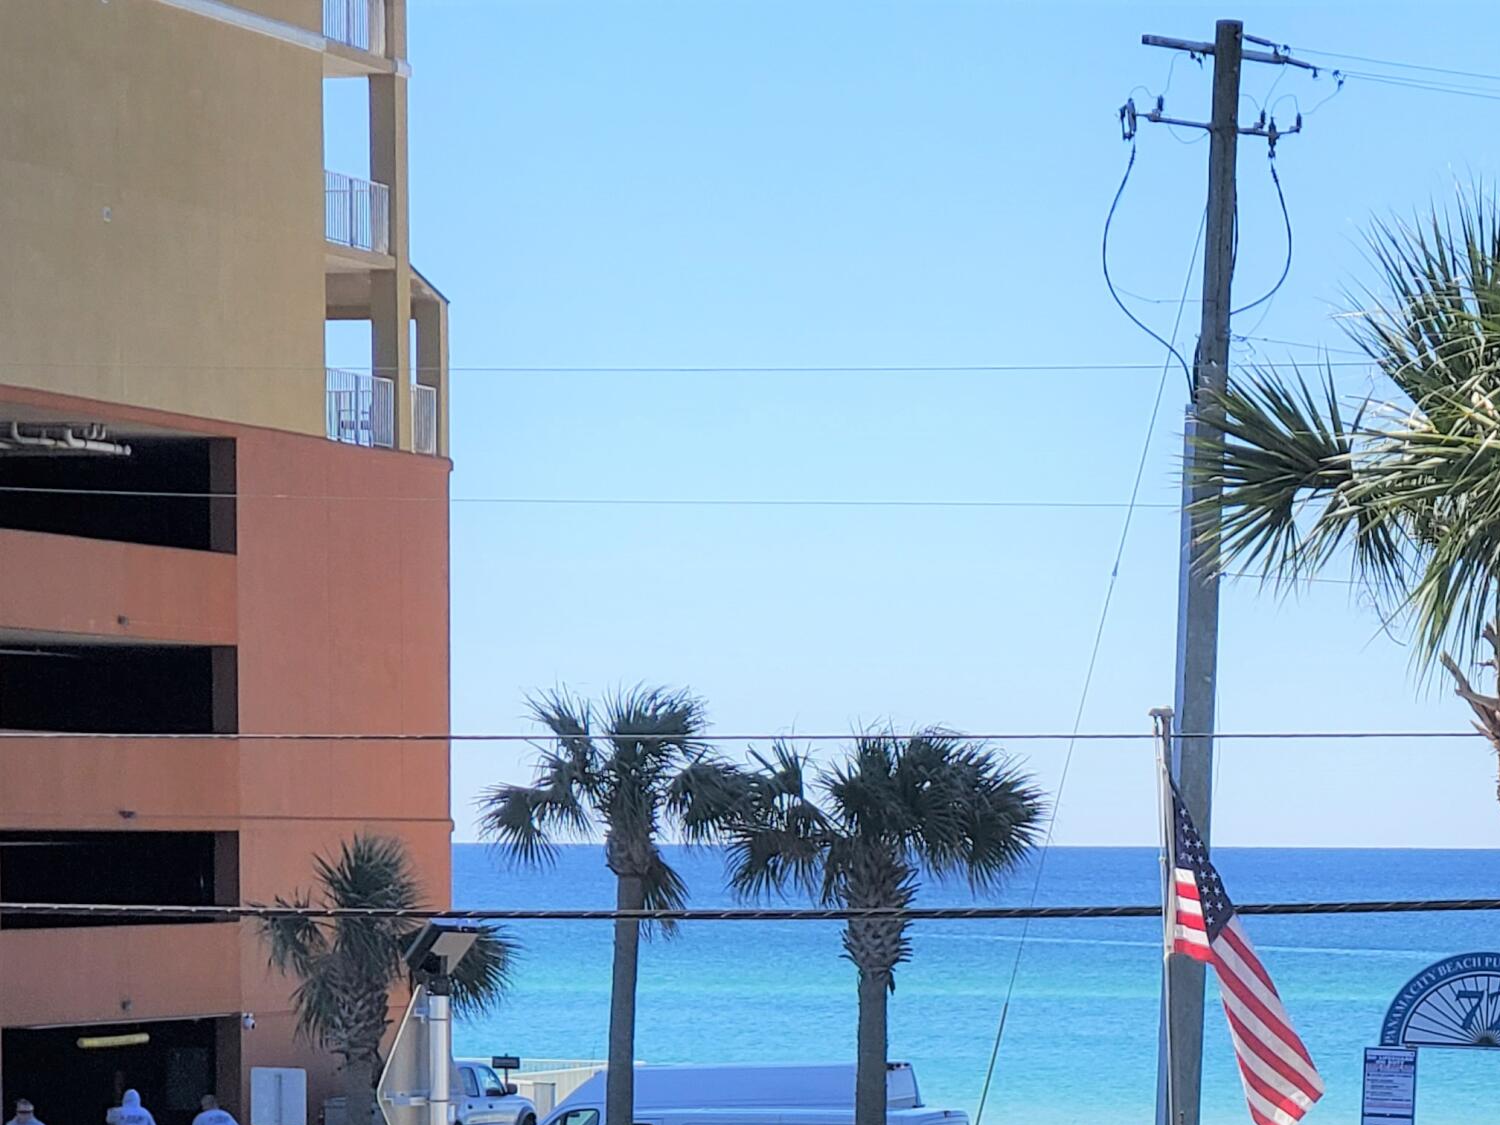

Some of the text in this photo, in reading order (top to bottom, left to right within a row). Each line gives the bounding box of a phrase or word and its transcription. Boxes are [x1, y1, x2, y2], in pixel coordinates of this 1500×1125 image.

[1384, 992, 1414, 1044] PANAMA
[1409, 970, 1437, 997] CITY
[1437, 956, 1482, 978] BEACH
